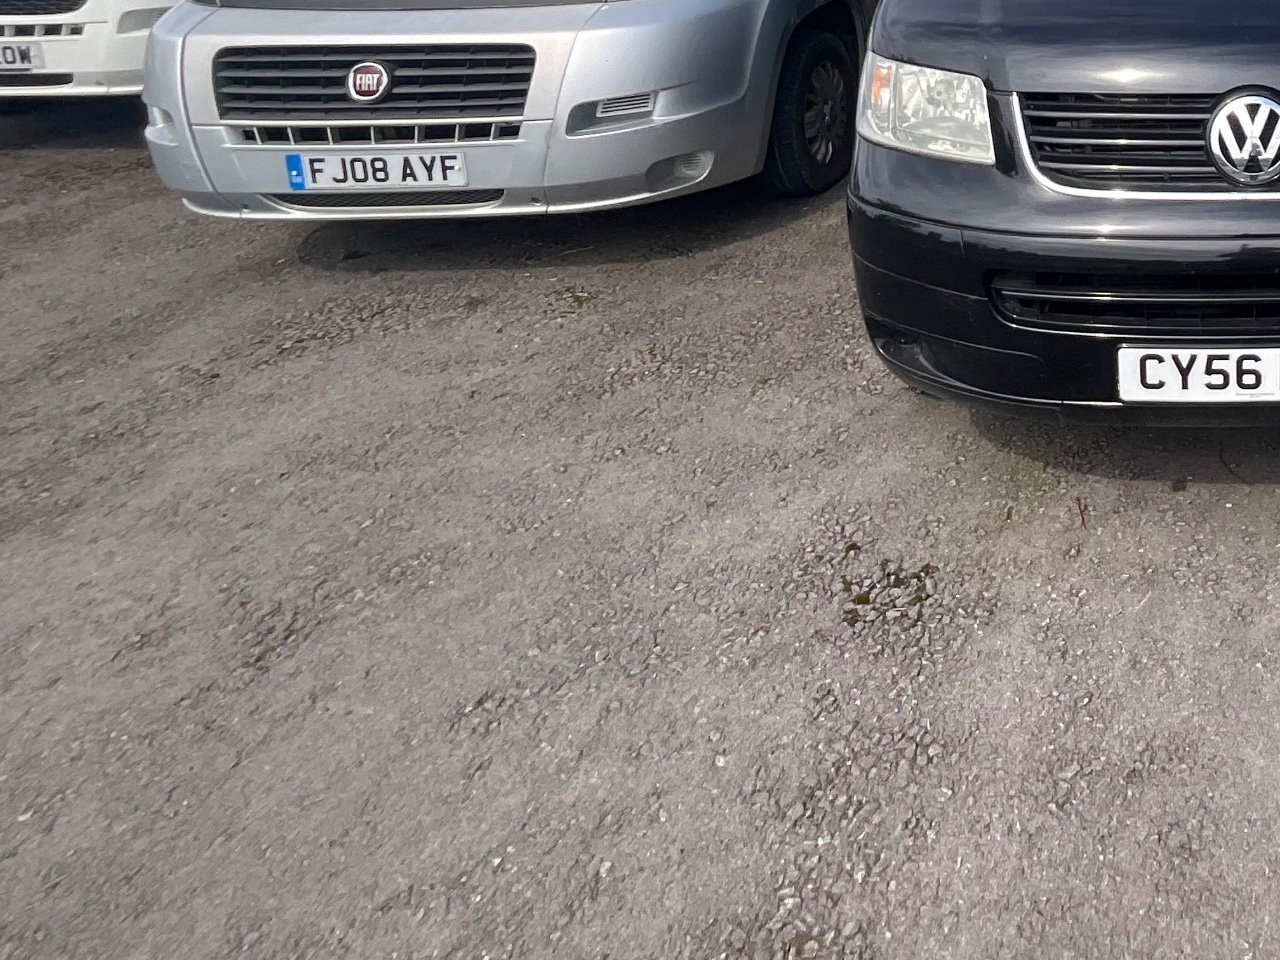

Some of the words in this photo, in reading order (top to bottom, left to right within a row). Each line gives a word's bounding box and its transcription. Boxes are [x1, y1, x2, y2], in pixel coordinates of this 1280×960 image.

[0, 45, 32, 65] OW
[355, 73, 380, 91] FIAT
[308, 157, 390, 184] FJ08
[401, 155, 459, 182] AYF
[1138, 353, 1263, 390] CY56
